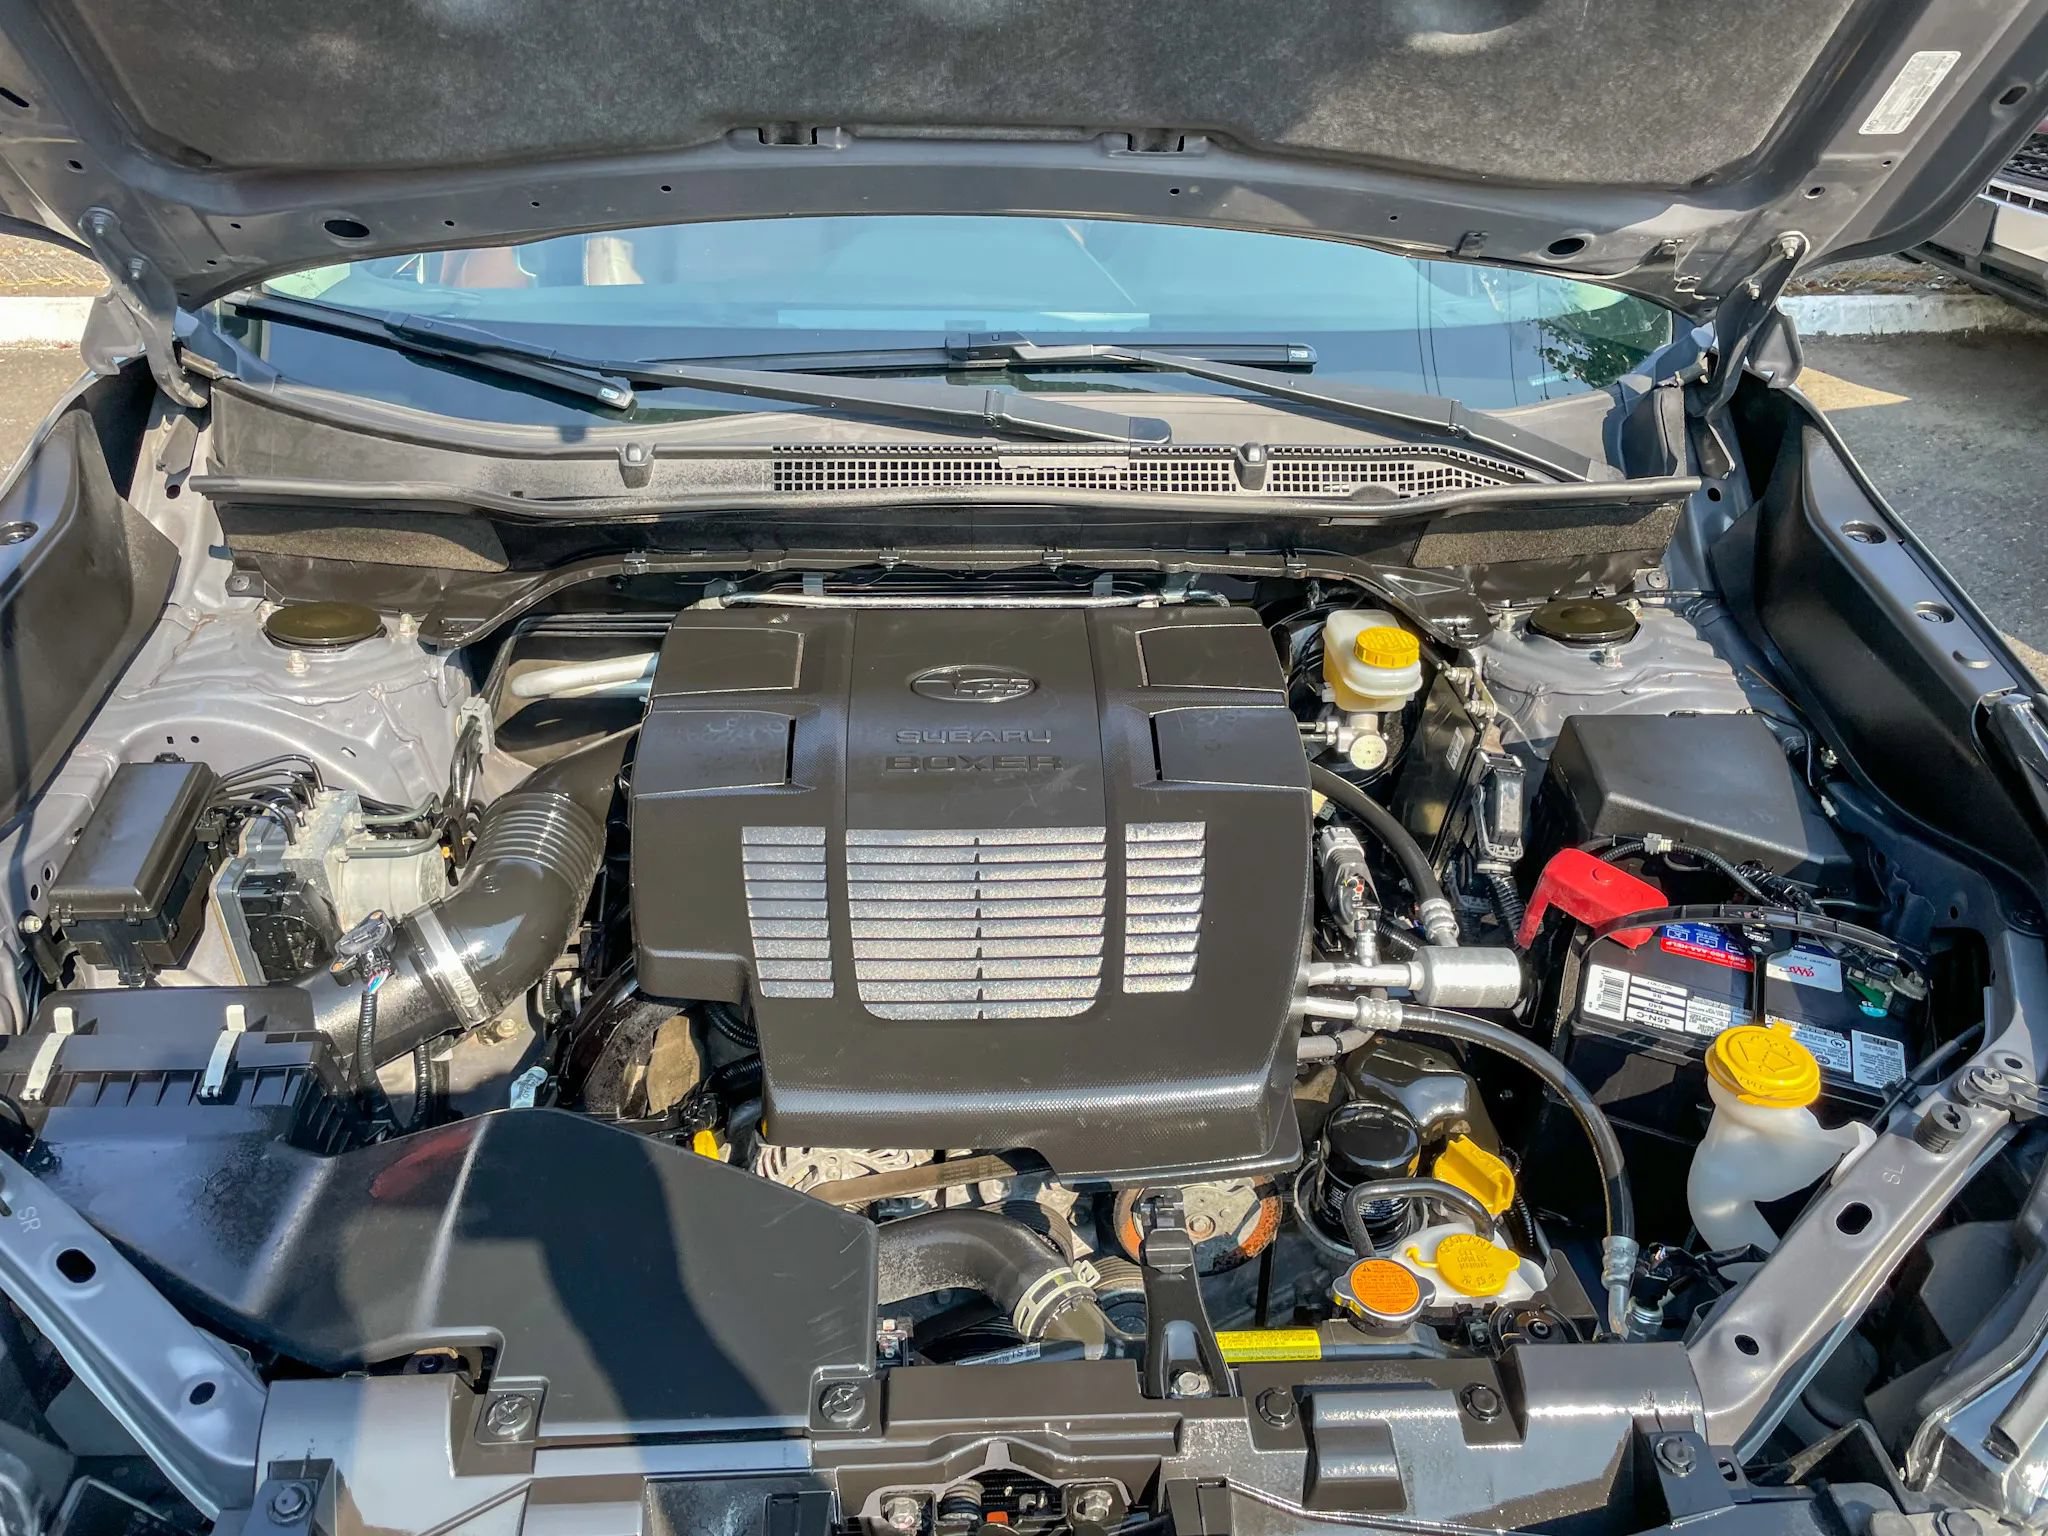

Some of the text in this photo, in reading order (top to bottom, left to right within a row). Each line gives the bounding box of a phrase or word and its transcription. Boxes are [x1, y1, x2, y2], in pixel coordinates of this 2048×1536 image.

[896, 729, 1051, 744] SUBARU
[886, 755, 1063, 773] BOXER
[1636, 1011, 1671, 1025] 35N-C
[1881, 1164, 1905, 1185] SL
[17, 1206, 41, 1233] SR
[1438, 1235, 1493, 1255] COOLANT
